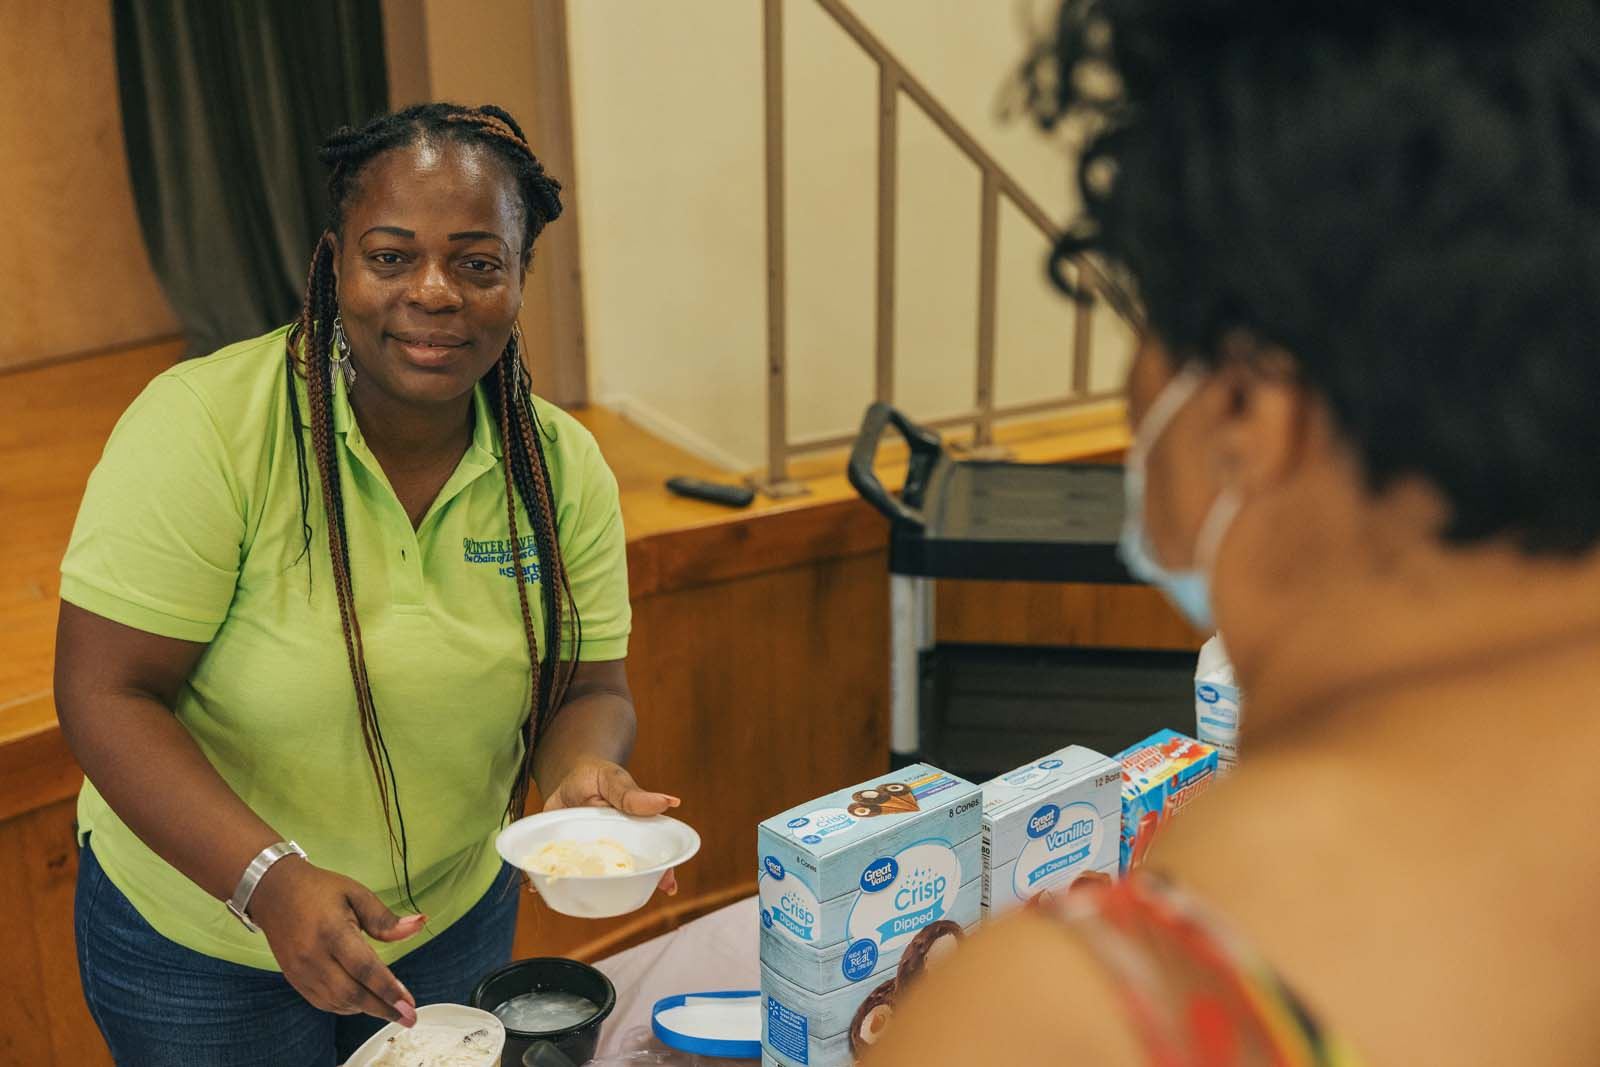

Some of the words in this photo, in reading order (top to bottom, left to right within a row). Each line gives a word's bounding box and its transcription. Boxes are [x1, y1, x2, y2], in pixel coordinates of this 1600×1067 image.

[463, 538, 504, 554] WINTER
[473, 554, 496, 563] Chain
[497, 553, 506, 564] of
[1095, 778, 1104, 788] 12
[1105, 772, 1120, 785] Bars
[949, 808, 954, 818] 8
[956, 799, 980, 816] Cones
[1031, 809, 1055, 828] Great
[1045, 819, 1094, 851] Vanilla
[864, 862, 892, 882] Great
[1034, 868, 1045, 880] Ice
[1046, 858, 1068, 873] Cream
[870, 872, 893, 887] Value
[894, 875, 947, 912] Crisp
[780, 895, 815, 926] Crisp
[893, 908, 934, 933] Dipped
